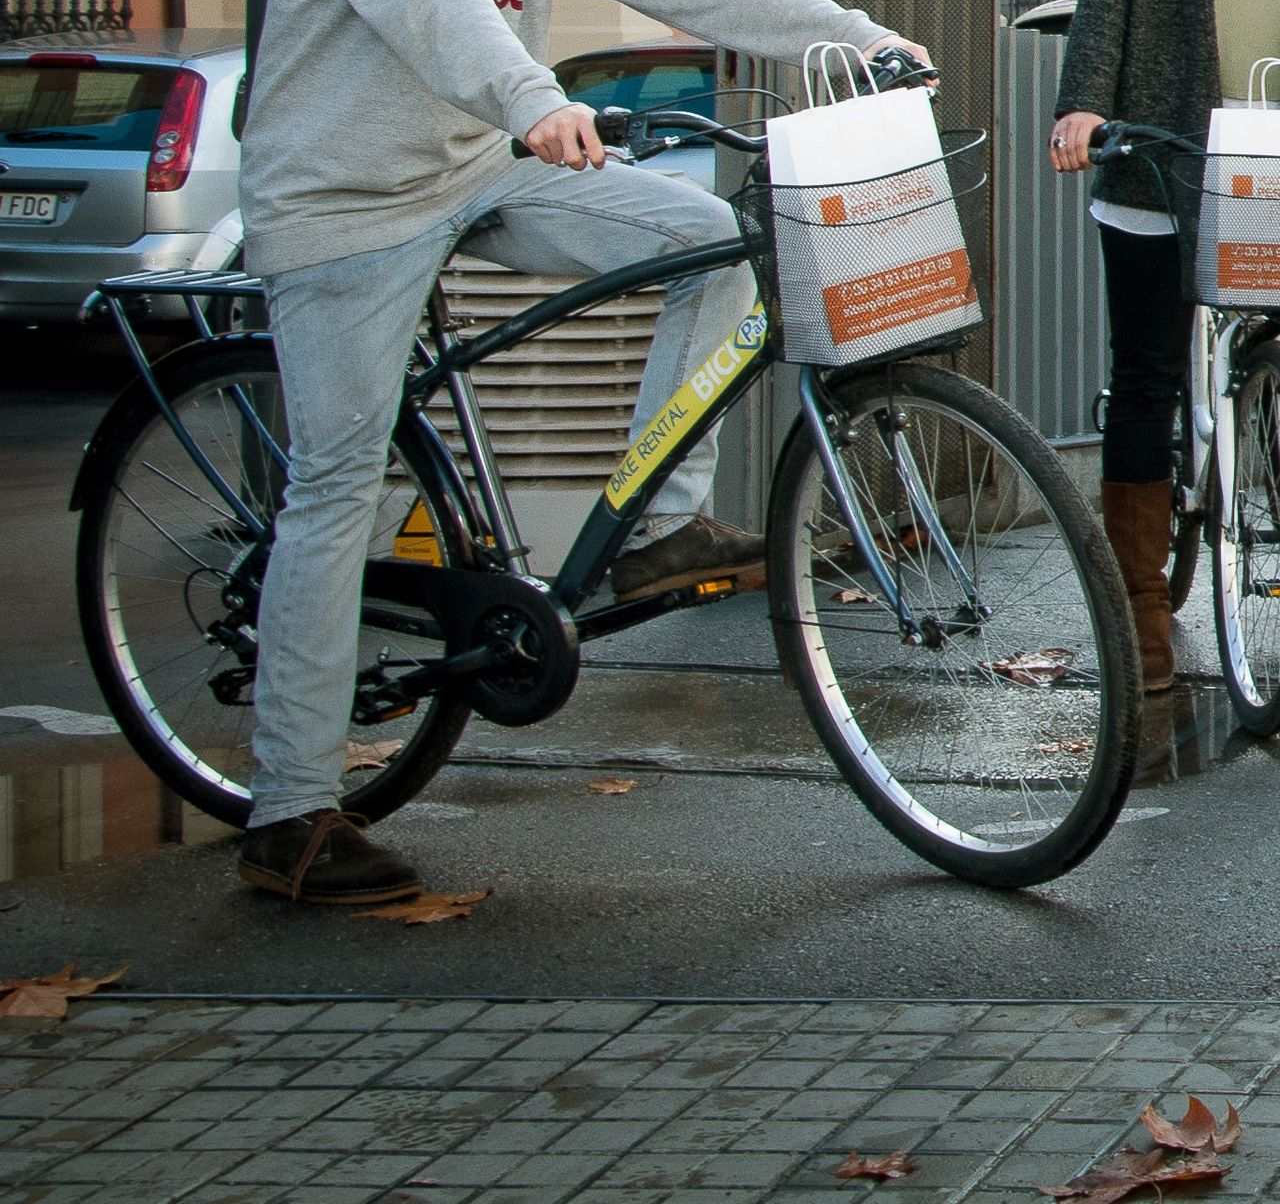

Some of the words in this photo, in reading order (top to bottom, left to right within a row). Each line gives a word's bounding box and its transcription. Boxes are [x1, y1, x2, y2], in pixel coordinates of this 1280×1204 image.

[9, 196, 50, 216] FDC
[611, 456, 639, 493] BIKE
[636, 403, 689, 461] RENTAL
[690, 343, 742, 402] BICI
[739, 312, 767, 344] Par
